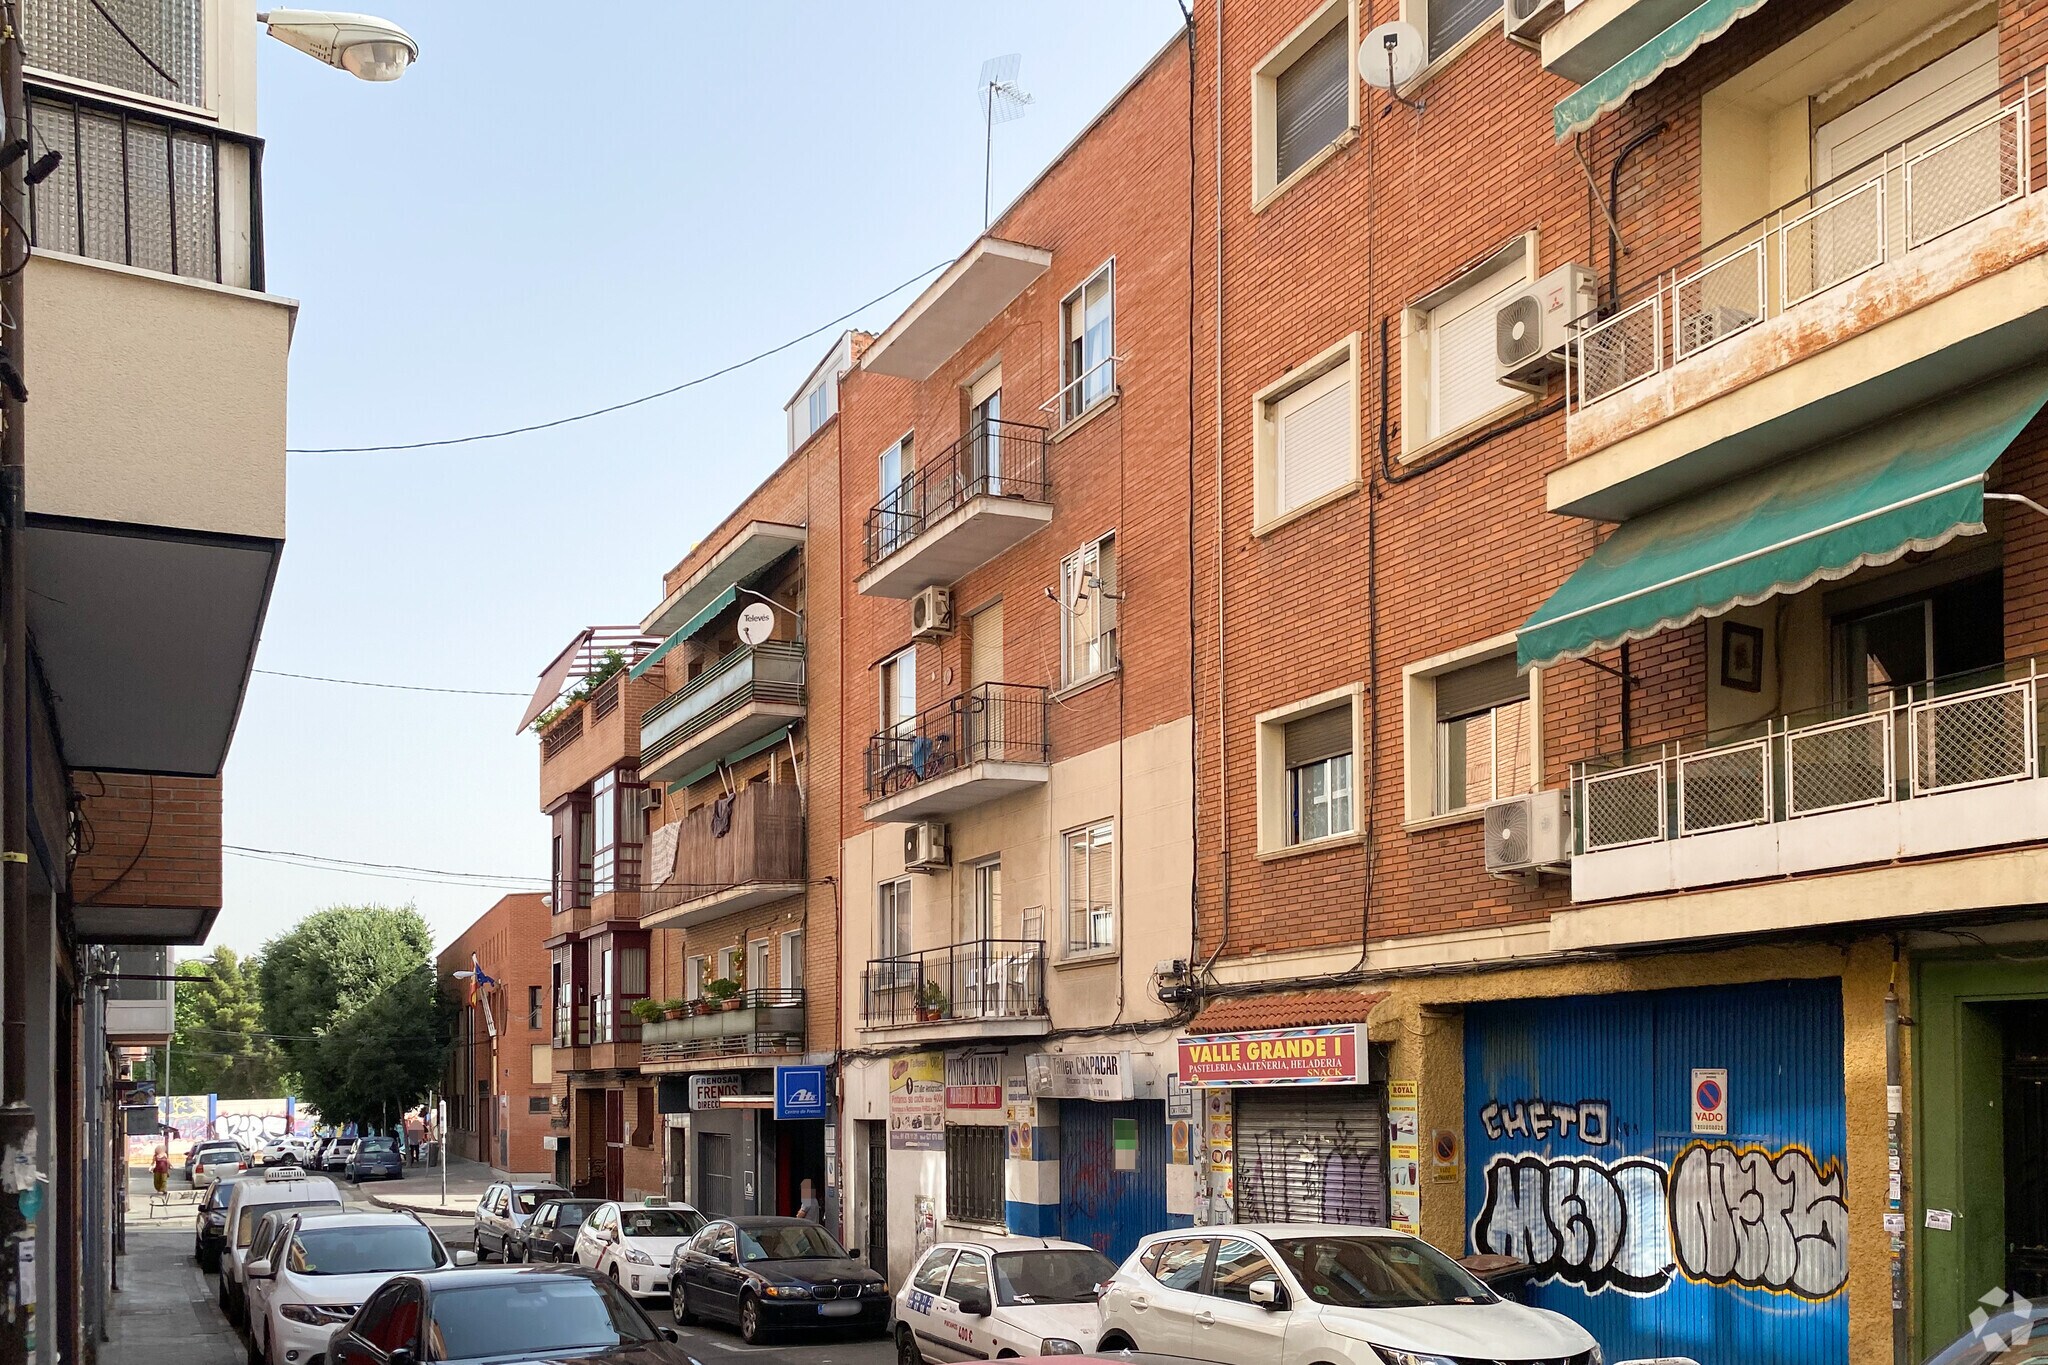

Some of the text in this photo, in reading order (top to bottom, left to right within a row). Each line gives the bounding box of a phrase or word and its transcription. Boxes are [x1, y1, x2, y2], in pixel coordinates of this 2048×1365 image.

[744, 614, 770, 623] Televés
[1189, 1037, 1341, 1063] VALLE GRANDE I
[978, 1057, 998, 1086] HORNO
[1052, 1055, 1119, 1076] Taller CHAPACAR
[1188, 1058, 1343, 1074] PASTELERIA, SALTEÑERIA, HELADERIA
[1306, 1067, 1343, 1077] SNACK
[695, 1075, 739, 1085] FRENOSAN
[697, 1085, 738, 1099] FRENOS
[1393, 1086, 1413, 1094] ROYAL
[1481, 1099, 1611, 1146] CHETO
[1695, 1112, 1723, 1121] VADO
